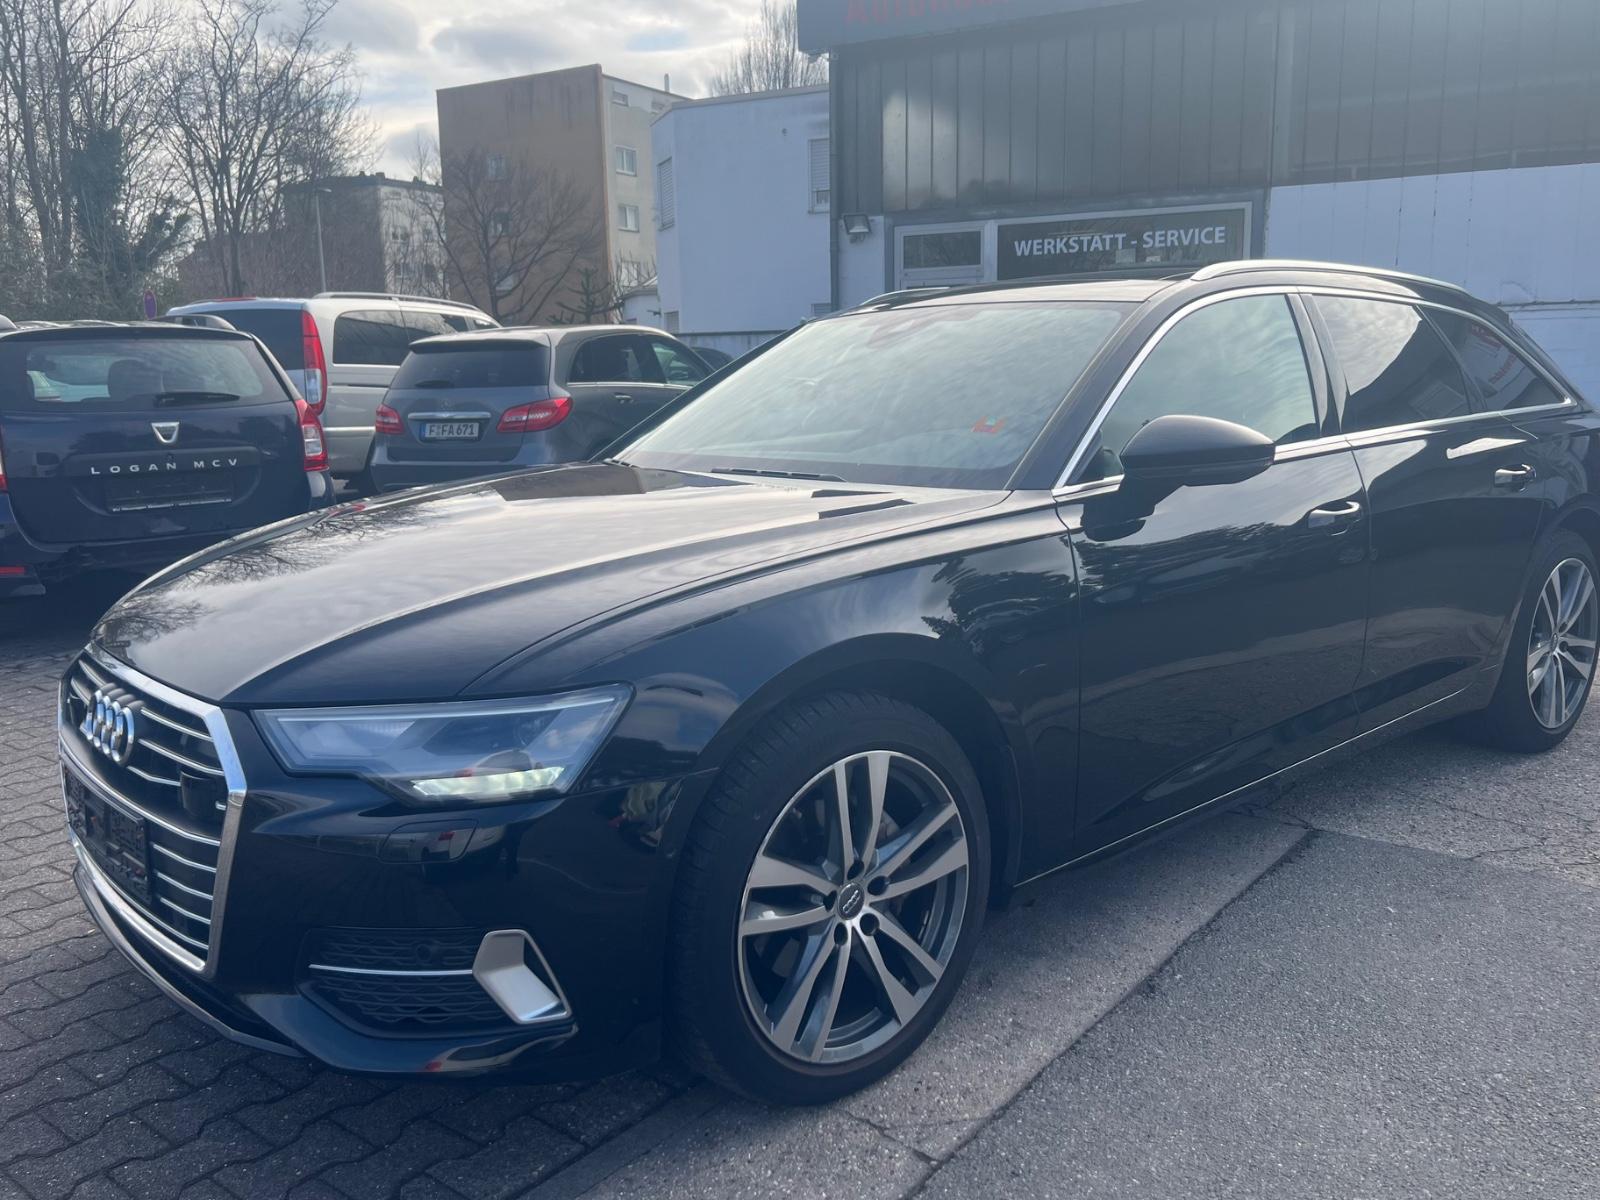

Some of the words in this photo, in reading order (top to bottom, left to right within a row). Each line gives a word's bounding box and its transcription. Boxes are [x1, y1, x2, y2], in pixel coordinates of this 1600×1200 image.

[1014, 233, 1127, 256] WERKSTATT
[1142, 226, 1226, 249] SERVICE
[90, 462, 177, 475] LOGAN
[193, 458, 238, 469] MCV
